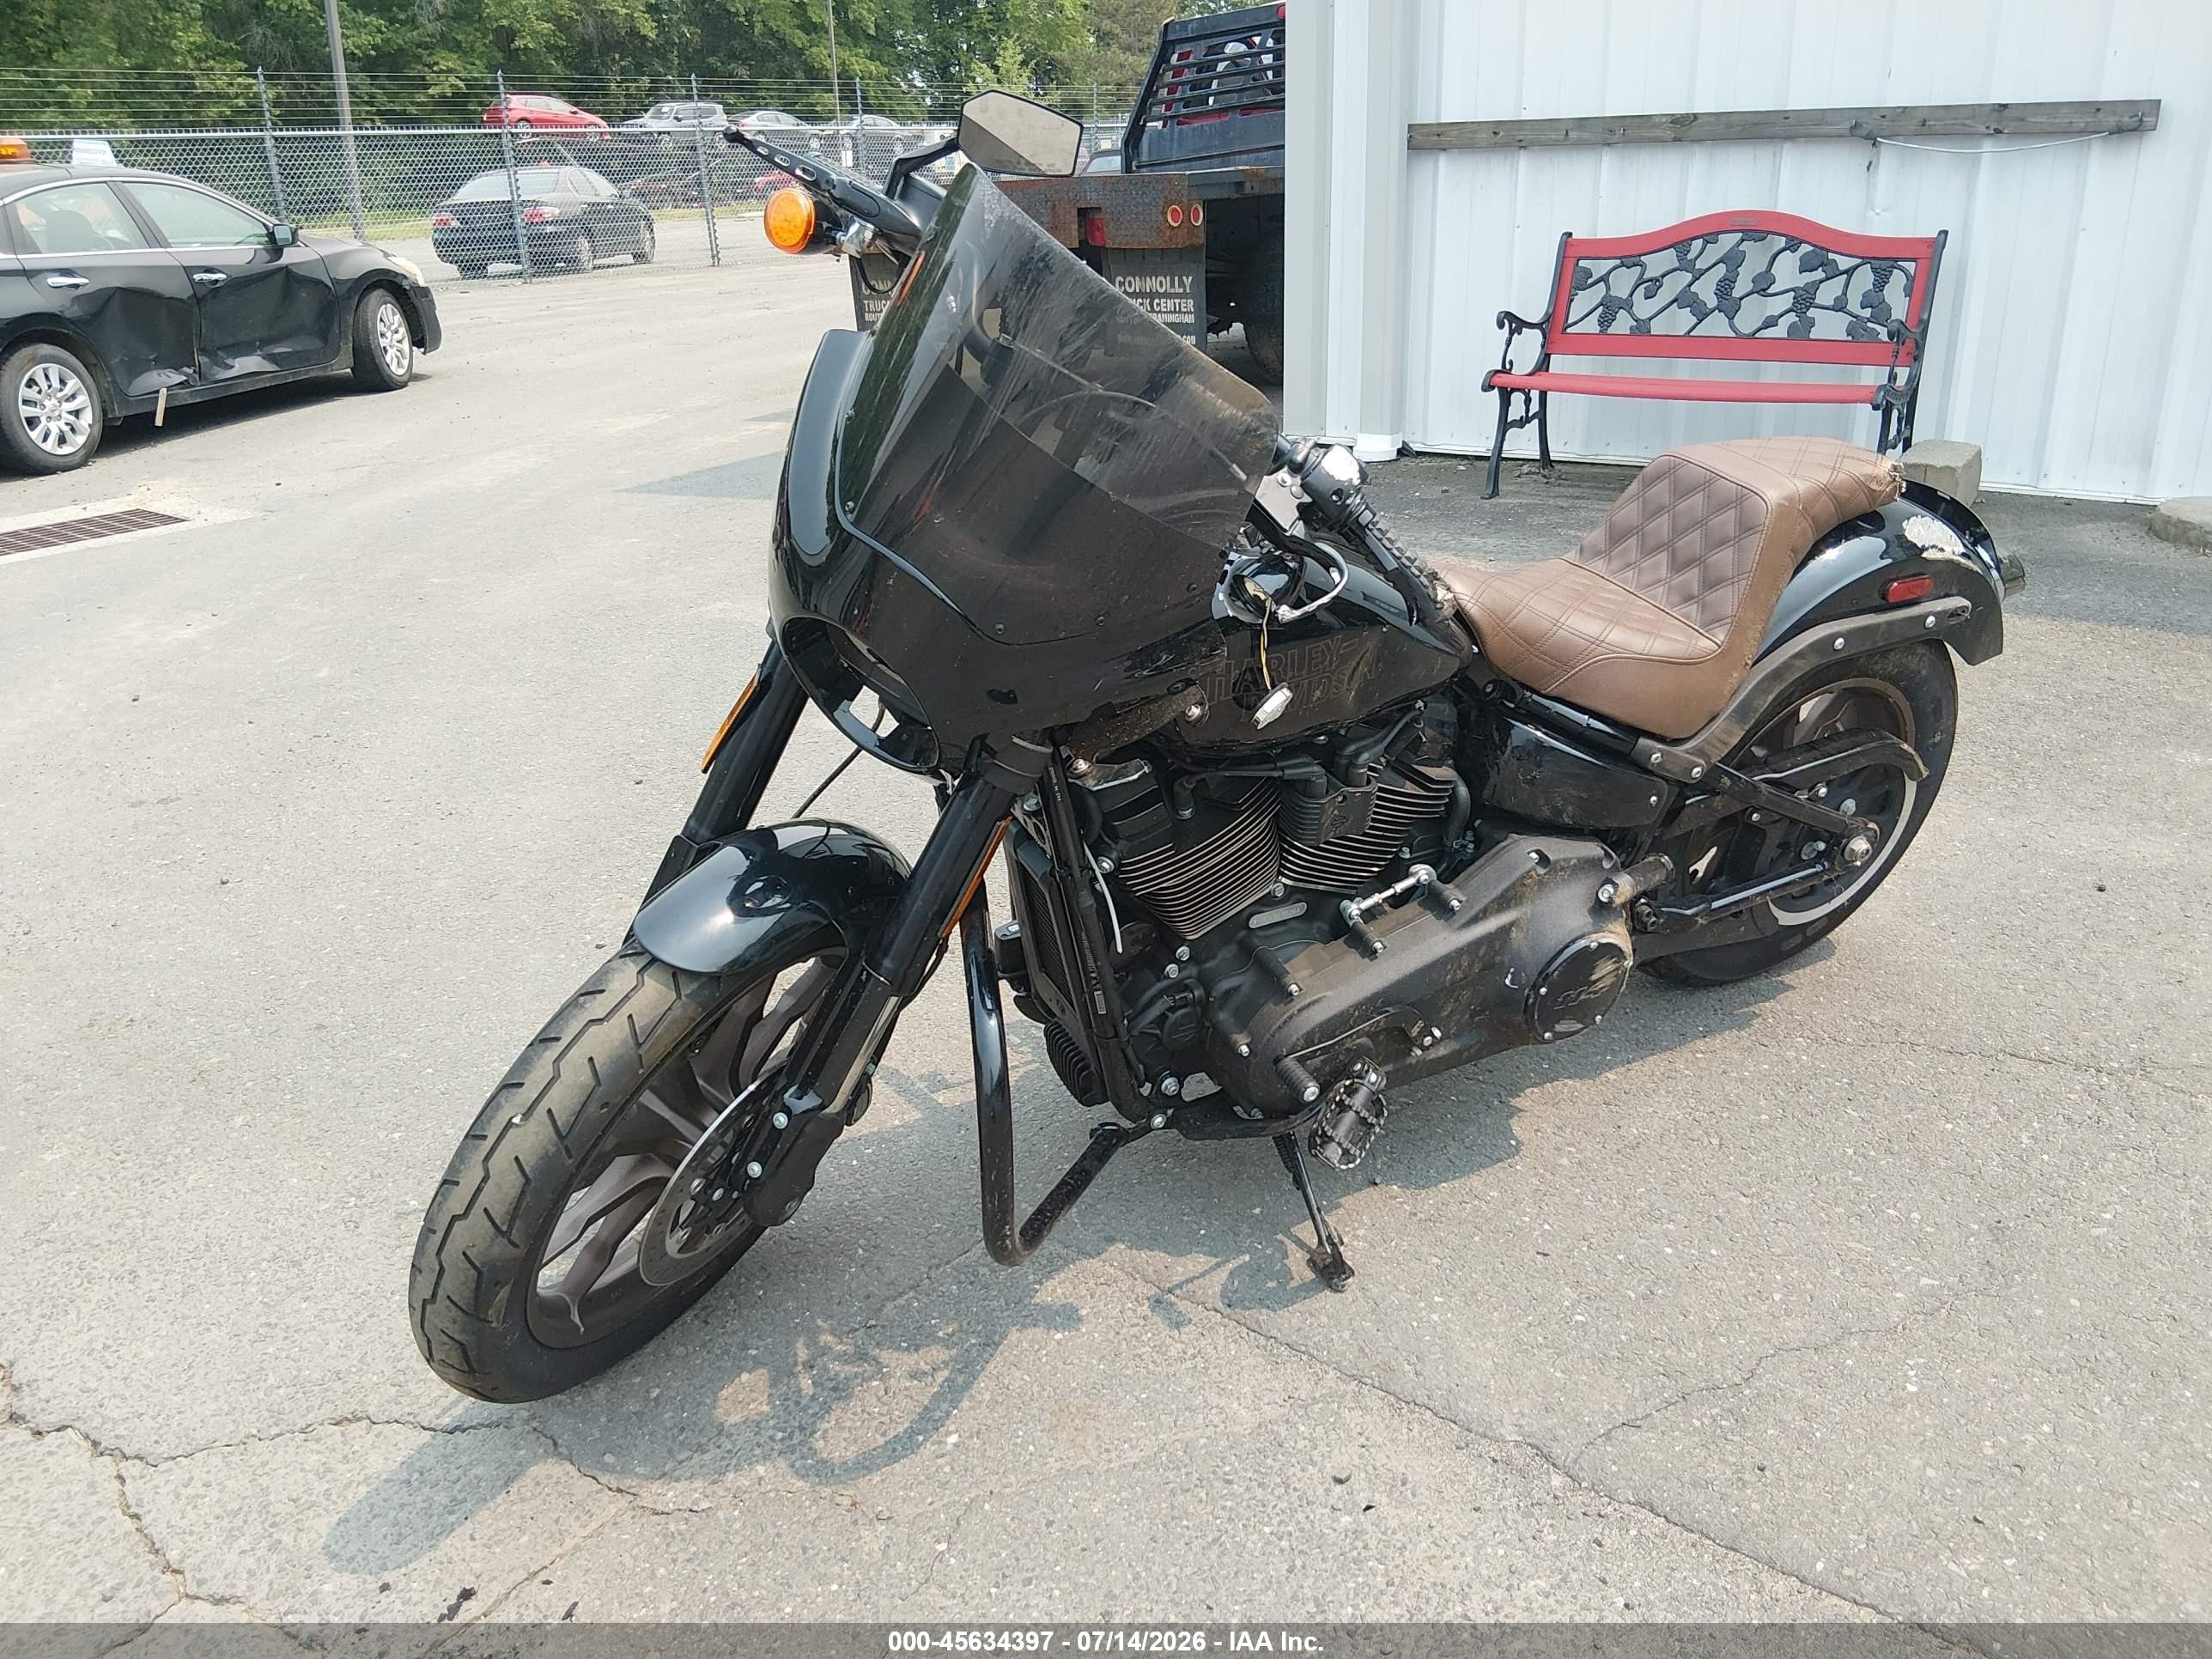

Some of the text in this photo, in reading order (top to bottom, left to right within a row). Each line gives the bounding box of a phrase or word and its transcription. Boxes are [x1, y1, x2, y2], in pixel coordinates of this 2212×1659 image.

[1115, 276, 1194, 293] CONNOLLY
[1153, 298, 1194, 313] CENTER
[1152, 312, 1195, 324] RAMINGHAM
